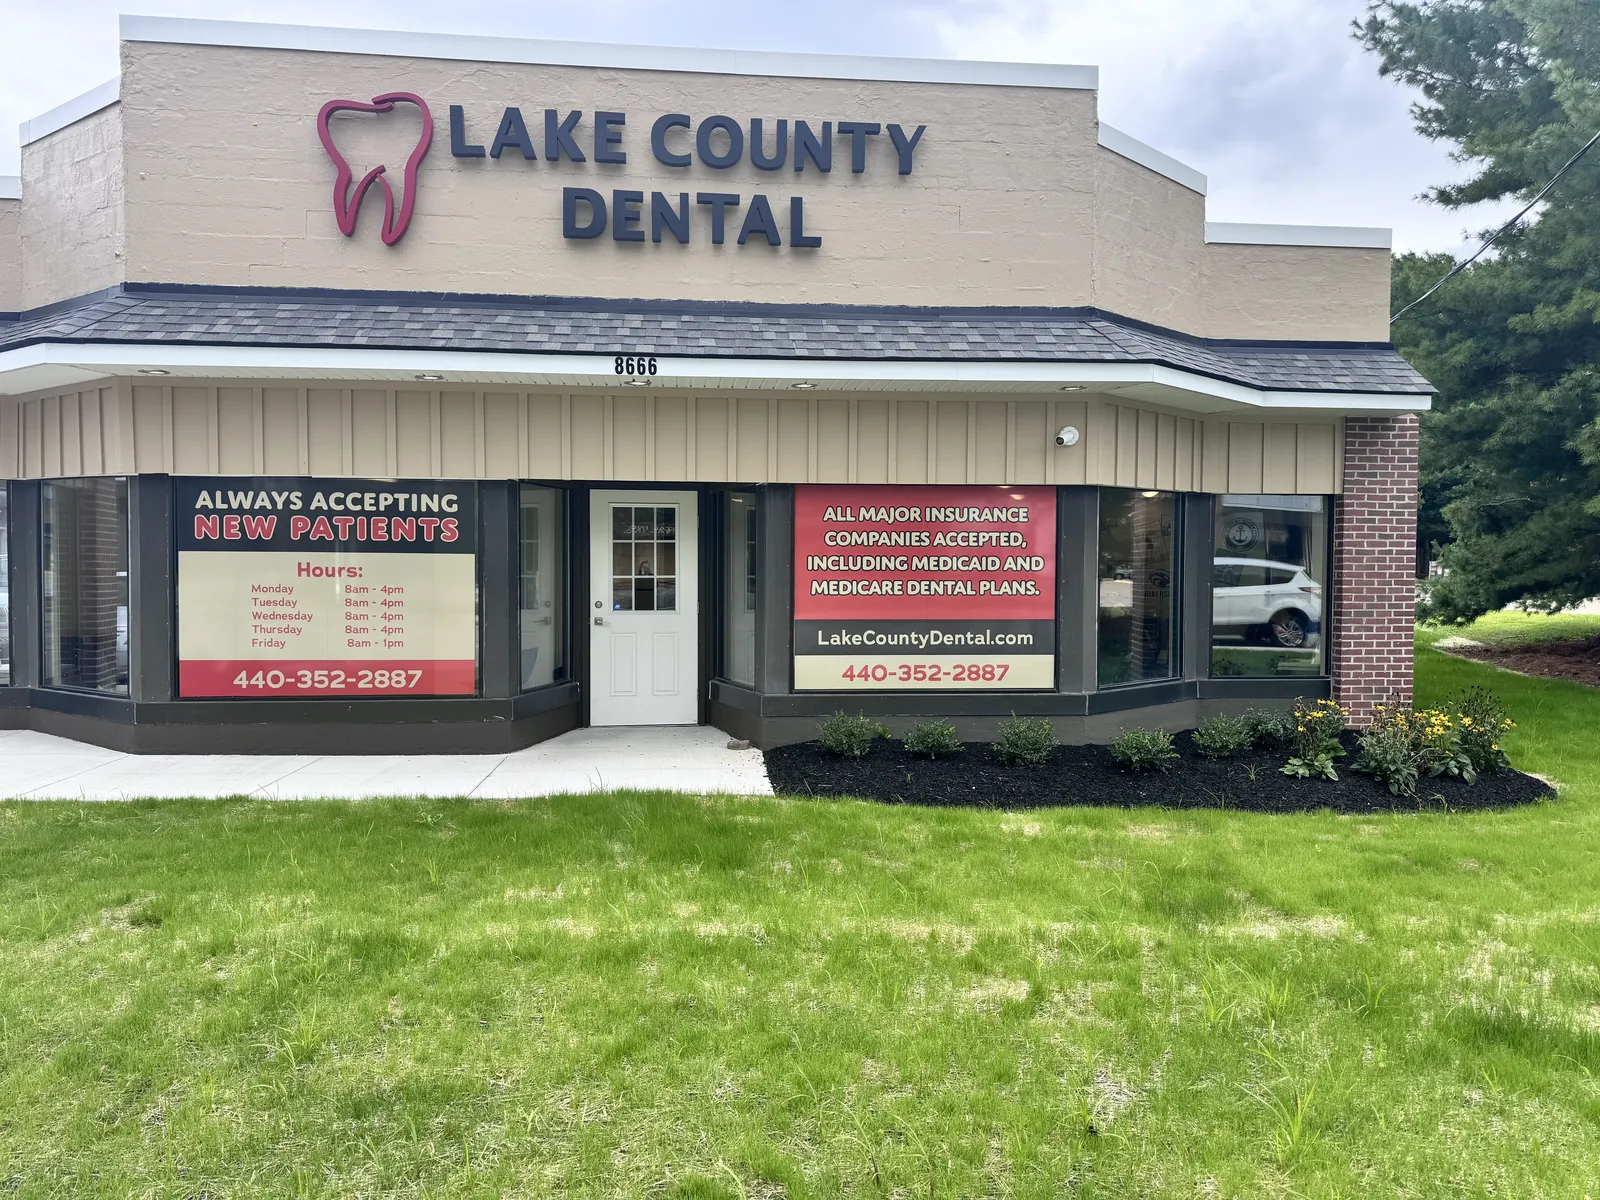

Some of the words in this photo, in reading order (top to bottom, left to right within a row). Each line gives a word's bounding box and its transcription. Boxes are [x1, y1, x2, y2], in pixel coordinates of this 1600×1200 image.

[448, 104, 628, 166] LAKE
[650, 113, 928, 176] COUNTY
[562, 187, 823, 248] DENTAL
[614, 356, 658, 376] 8666
[195, 490, 303, 511] ALWAYS
[310, 492, 459, 513] ACCEPTING
[822, 506, 856, 522] ALL
[858, 506, 922, 525] MAJOR
[925, 507, 1029, 523] INSURANCE
[194, 514, 277, 541] NEW
[290, 515, 459, 543] PATIENTS
[824, 531, 930, 548] COMPANIES
[932, 531, 1028, 549] ACCEPTED,
[297, 562, 363, 578] Hours:
[806, 555, 908, 572] INCLUDING
[911, 556, 1001, 572] MEDICAID
[1003, 556, 1045, 572] AND
[251, 584, 294, 595] Monday
[344, 585, 369, 594] 8am
[380, 585, 404, 596] 4pm
[810, 580, 903, 596] MEDICARE
[906, 580, 977, 596] DENTAL
[979, 580, 1041, 596] PLANS.
[251, 598, 298, 609] Tuesday
[344, 598, 369, 607] 8am
[380, 598, 404, 609] 4pm
[251, 611, 314, 623] Wednesday
[344, 612, 369, 621] 8am
[380, 612, 404, 623] 4pm
[251, 625, 303, 636] Thursday
[344, 625, 369, 634] 8am
[380, 625, 404, 636] 4pm
[817, 629, 1034, 649] LakeCountyDental.com
[251, 638, 286, 650] Friday
[347, 639, 372, 648] 8am
[383, 639, 404, 650] 1pm
[233, 669, 423, 690] 440-352-2887
[841, 664, 1010, 682] 440-352-2887
